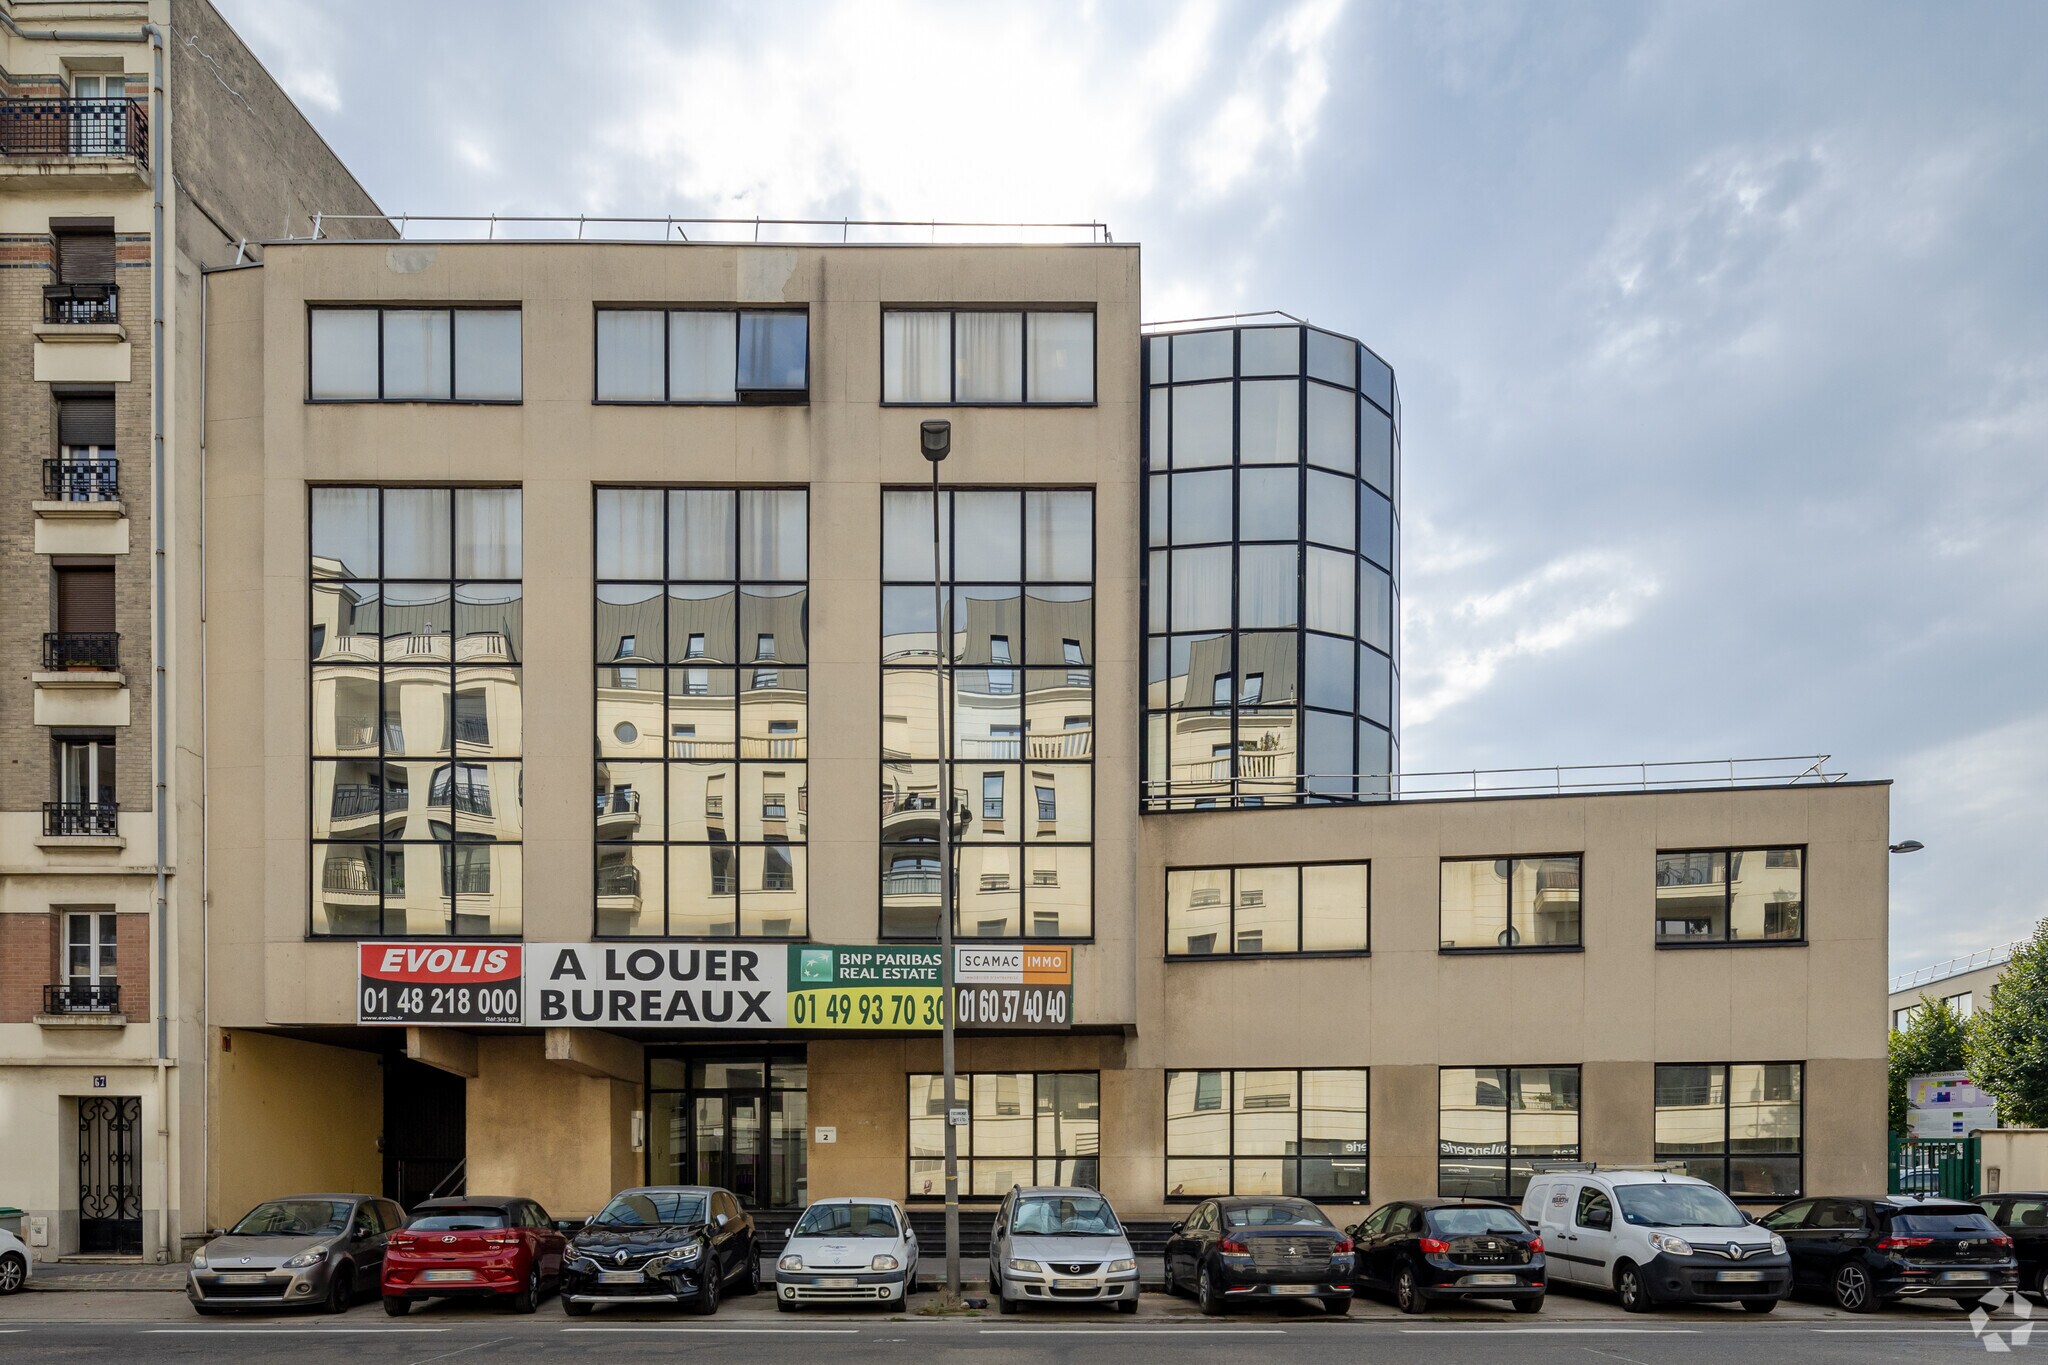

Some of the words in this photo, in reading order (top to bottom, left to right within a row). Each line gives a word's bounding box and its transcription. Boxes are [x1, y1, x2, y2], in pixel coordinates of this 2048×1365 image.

[379, 948, 509, 974] EVOLIS
[549, 948, 587, 981] A
[605, 948, 760, 982] LOUER
[839, 953, 873, 965] BNP
[876, 953, 943, 966] PARIBAS
[839, 967, 879, 979] REAL
[882, 967, 937, 980] ESTATE
[965, 955, 1019, 967] SCAMAC
[1027, 956, 1062, 968] IMMO
[363, 987, 388, 1014] 01
[397, 987, 424, 1014] 48
[430, 987, 471, 1014] 218
[478, 988, 518, 1015] 000
[540, 989, 772, 1023] BUREAUX
[794, 993, 816, 1024] 01
[826, 994, 851, 1024] 49
[858, 994, 884, 1025] 93
[891, 994, 916, 1025] 70
[959, 989, 976, 1023] 01
[979, 989, 999, 1023] 60
[1002, 990, 1020, 1023] 37
[1022, 990, 1043, 1023] 40
[1046, 990, 1066, 1024] 40
